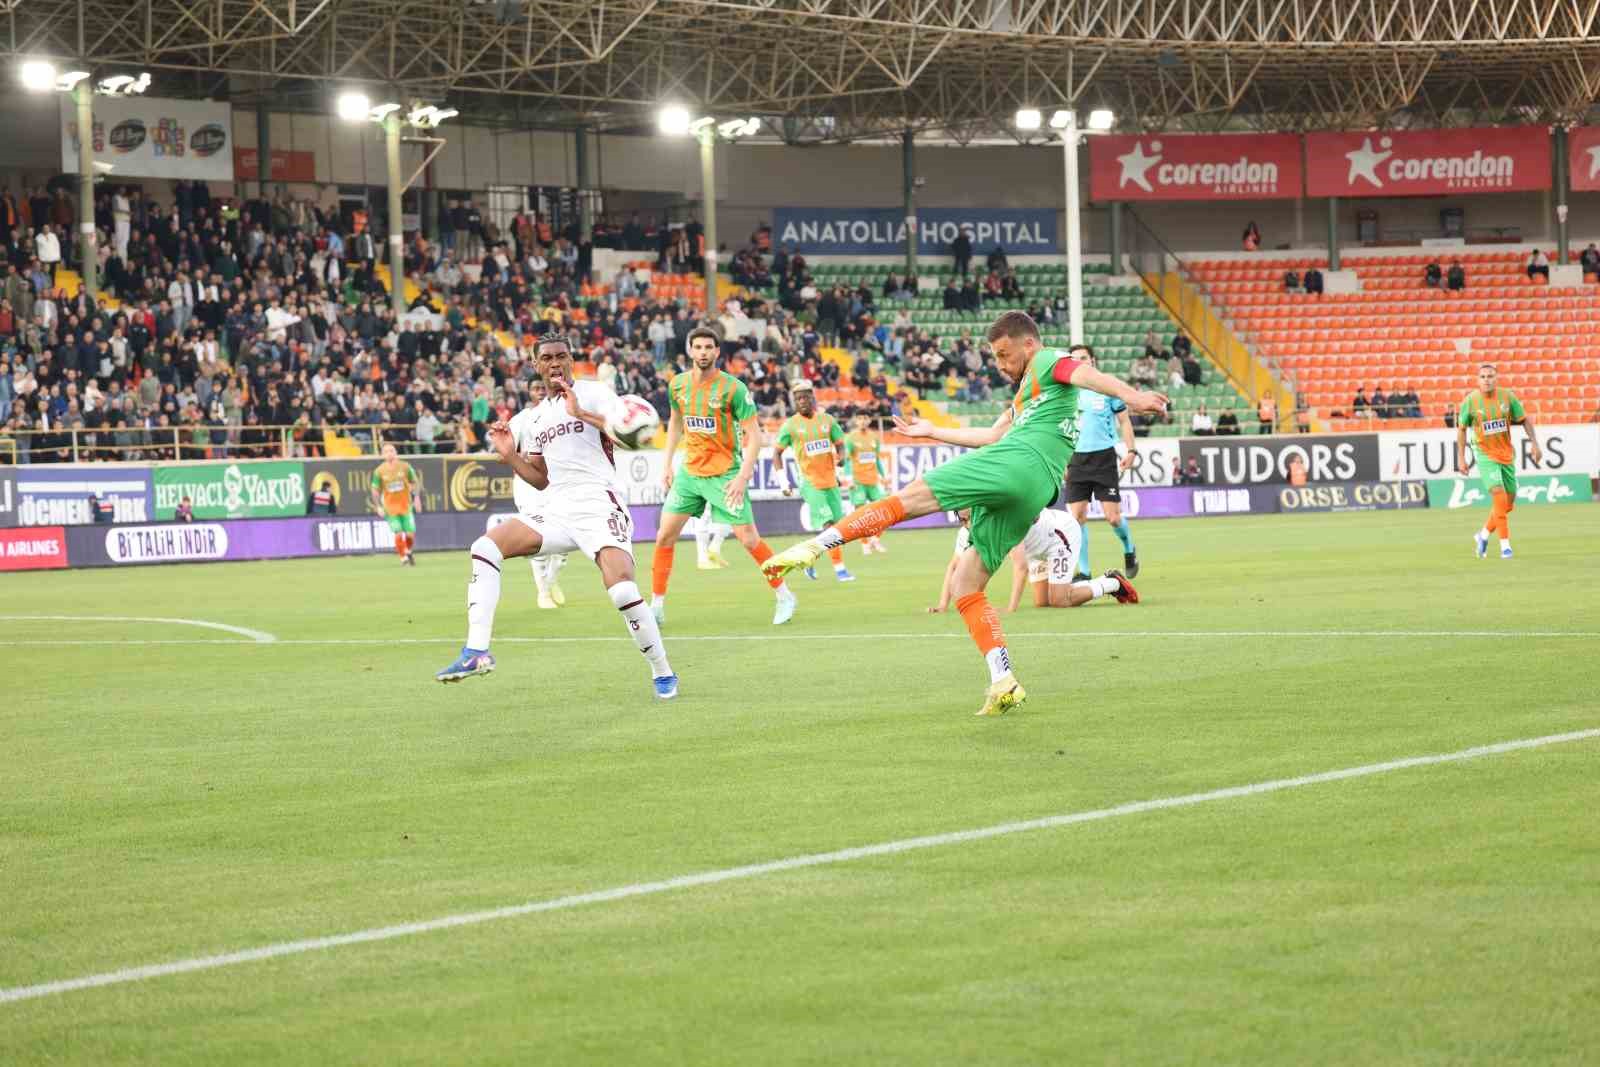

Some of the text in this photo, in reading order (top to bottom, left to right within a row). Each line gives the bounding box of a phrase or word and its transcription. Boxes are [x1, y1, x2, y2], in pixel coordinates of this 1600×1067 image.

[1158, 156, 1278, 185] corendon
[1388, 150, 1514, 180] corendon
[1214, 184, 1278, 194] AIRLINES
[1448, 176, 1513, 188] AIRLINES
[921, 220, 1049, 244] HOSPITAL
[1201, 442, 1357, 485] TUDORS
[1398, 436, 1566, 475] TUDRS
[155, 472, 304, 509] HELVACI YAKUB
[1354, 481, 1426, 505] GOLD
[1448, 479, 1485, 509] La
[8, 540, 60, 557] AIRLINES
[1053, 557, 1069, 574] 26
